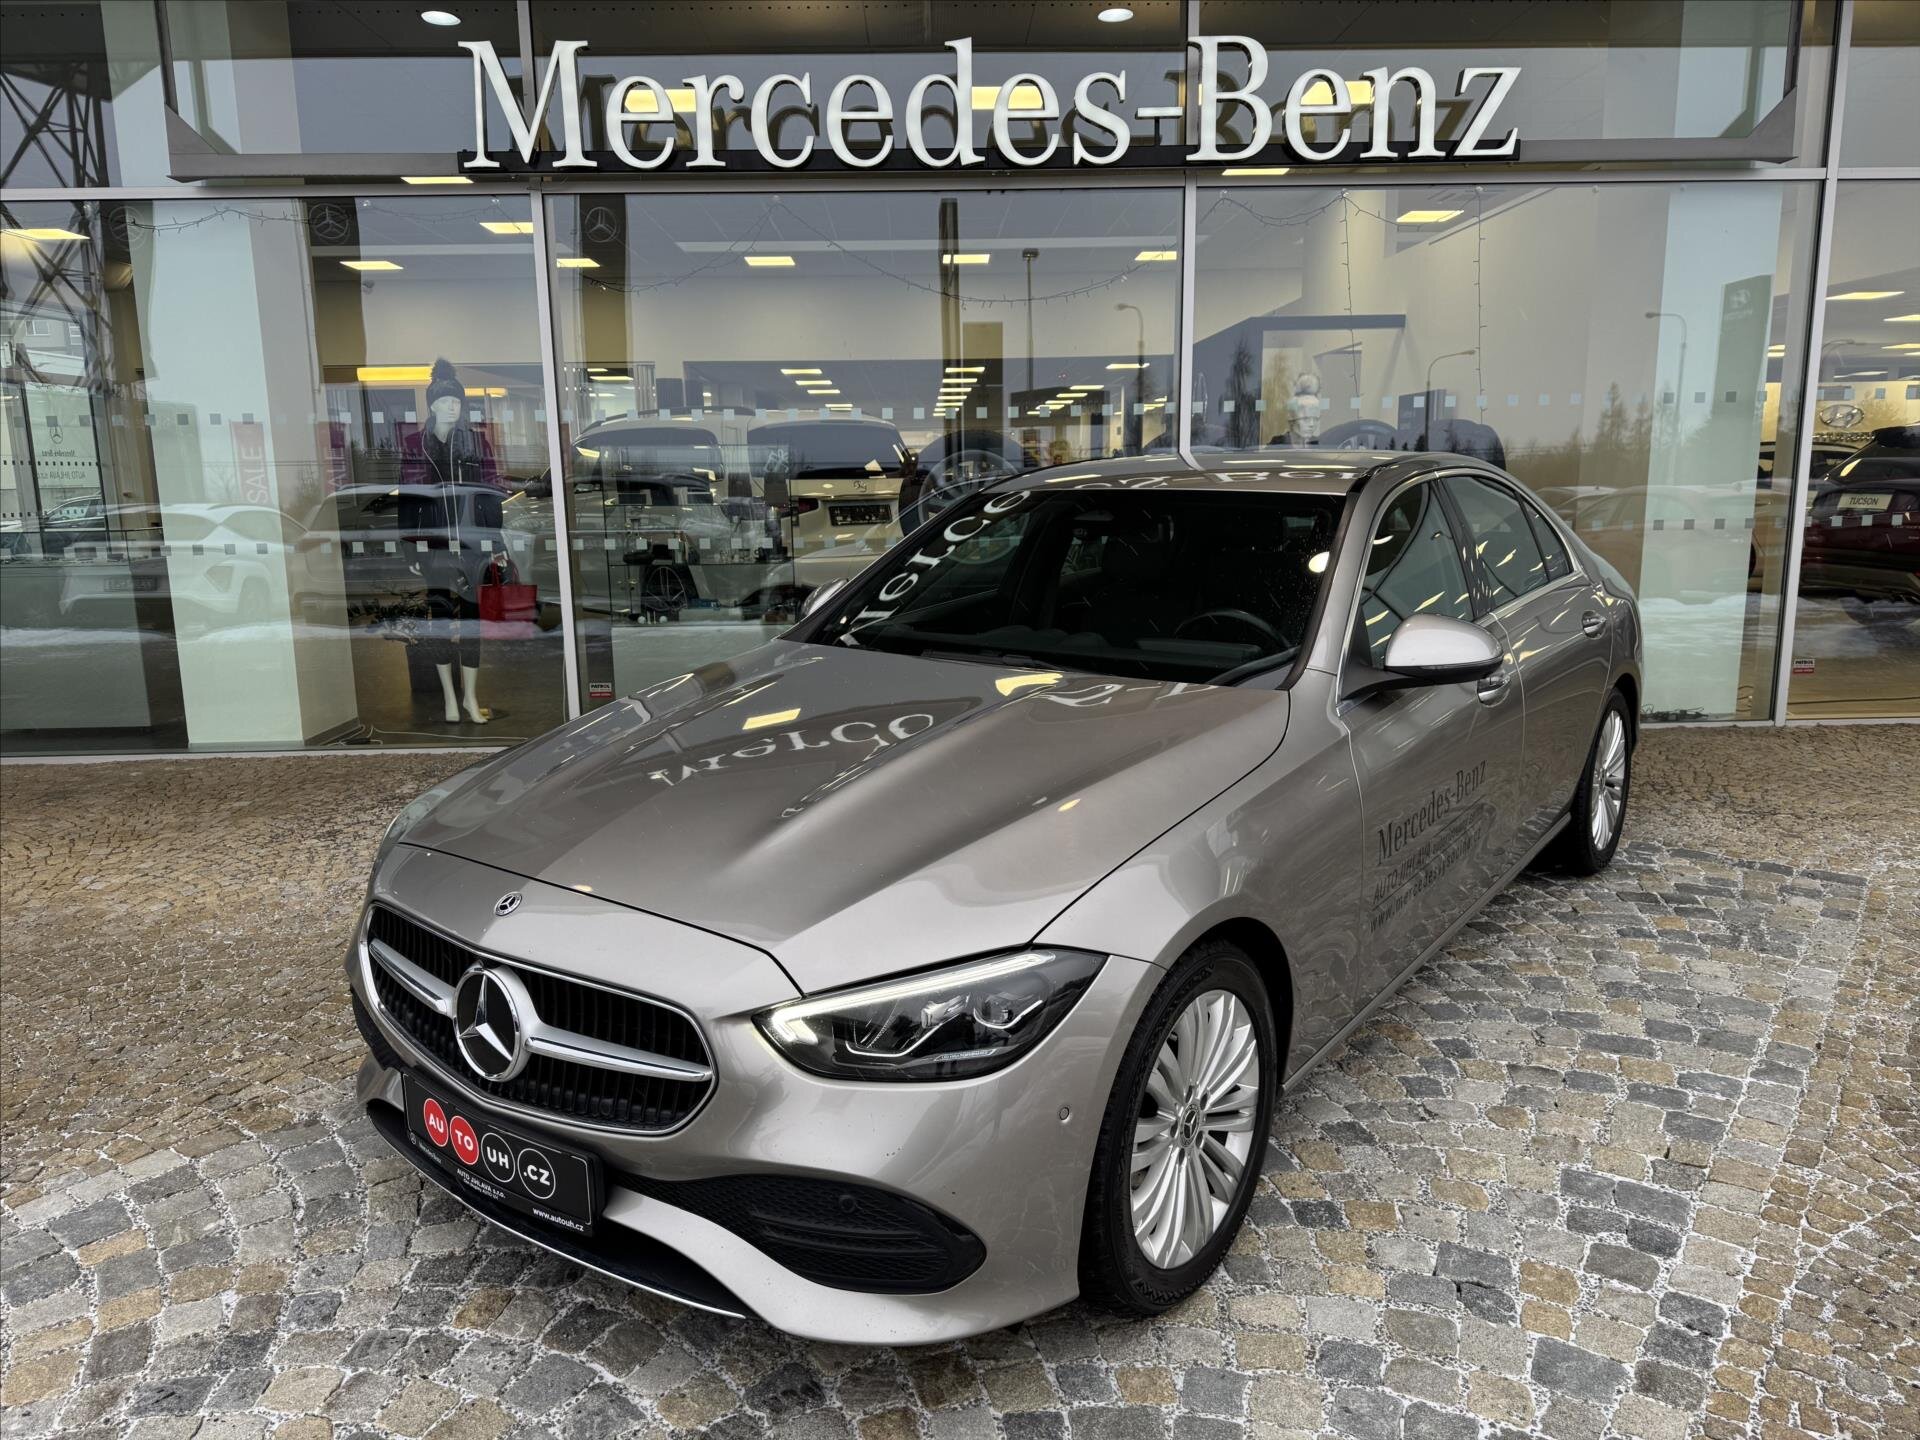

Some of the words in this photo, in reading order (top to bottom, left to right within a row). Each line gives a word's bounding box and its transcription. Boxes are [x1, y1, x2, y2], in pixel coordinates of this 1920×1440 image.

[457, 34, 1522, 170] Mercedes-Benz
[241, 446, 269, 504] SALE
[1849, 496, 1879, 505] TUCSON
[1377, 760, 1488, 867] Mercedes-Benz
[1373, 868, 1398, 905] AUTO
[428, 1113, 444, 1134] AU
[454, 1129, 474, 1151] TO
[486, 1146, 510, 1170] UH
[523, 1164, 551, 1186] .CZ
[456, 1168, 470, 1182] AUTO
[532, 1207, 585, 1233] www.autouh.cz
